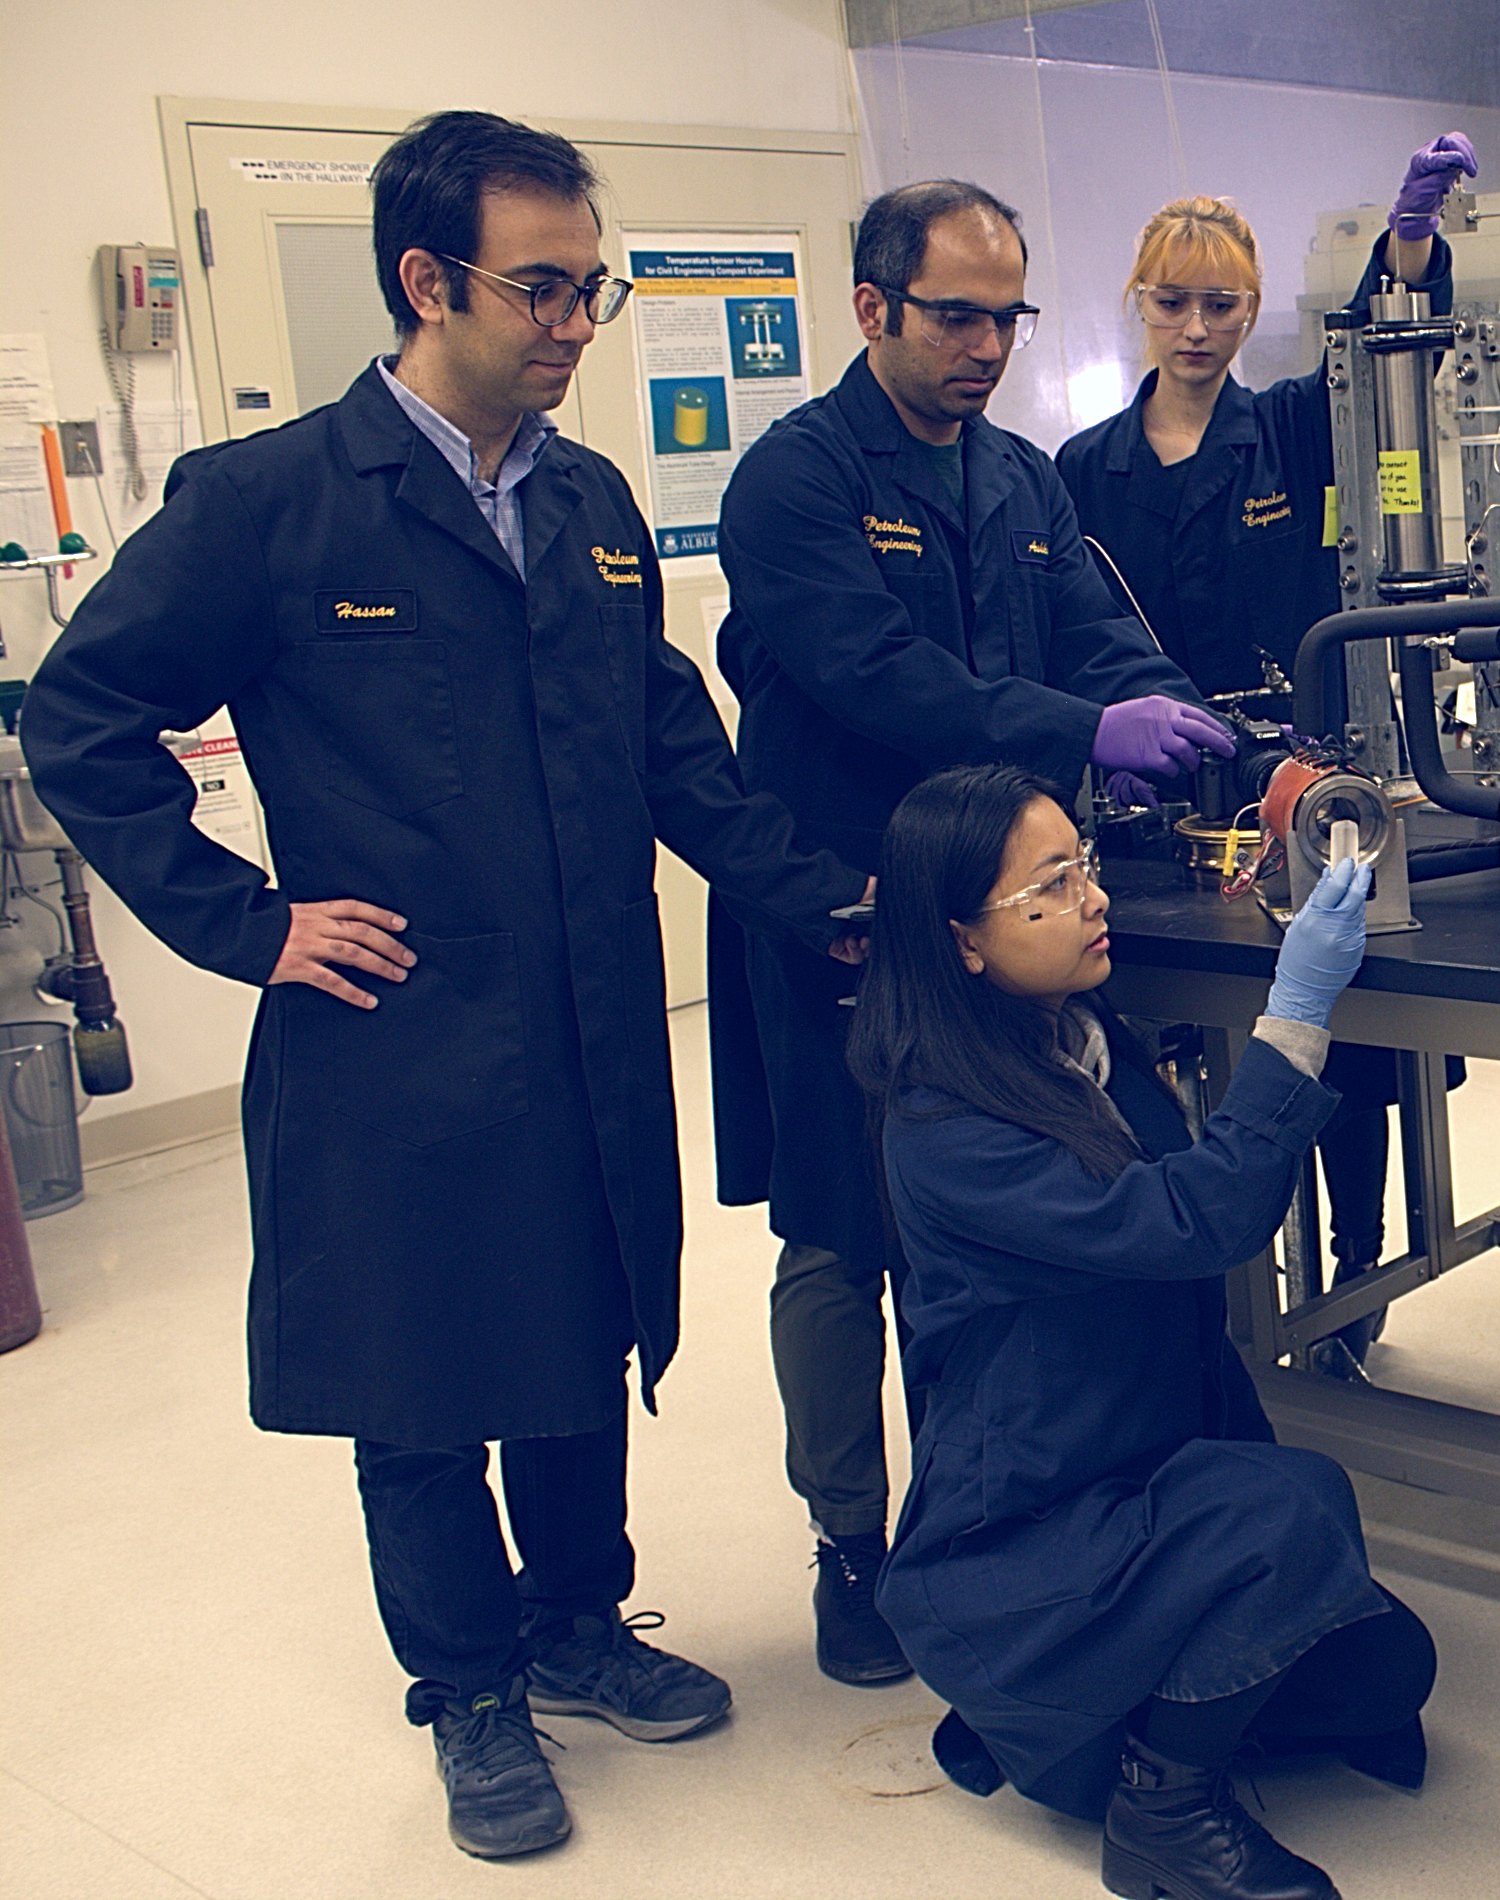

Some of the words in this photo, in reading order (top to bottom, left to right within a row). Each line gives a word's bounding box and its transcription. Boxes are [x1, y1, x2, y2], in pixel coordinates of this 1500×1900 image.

[267, 160, 327, 171] EMERGENCY
[330, 162, 370, 172] SHOWER
[296, 174, 312, 182] THE
[665, 256, 708, 266] Temperature
[711, 256, 734, 265] Sensor
[736, 257, 764, 266] Housing
[645, 267, 655, 275] for
[656, 267, 672, 275] Civil
[674, 267, 715, 277] Engineering
[716, 267, 746, 276] Compost
[748, 267, 784, 276] Experiment
[863, 515, 921, 537] Petroleum
[866, 533, 923, 558] Engineering
[591, 547, 639, 565] Ptroleum
[335, 602, 396, 619] Hassan
[1256, 732, 1280, 740] Canon
[205, 782, 221, 790] NO
